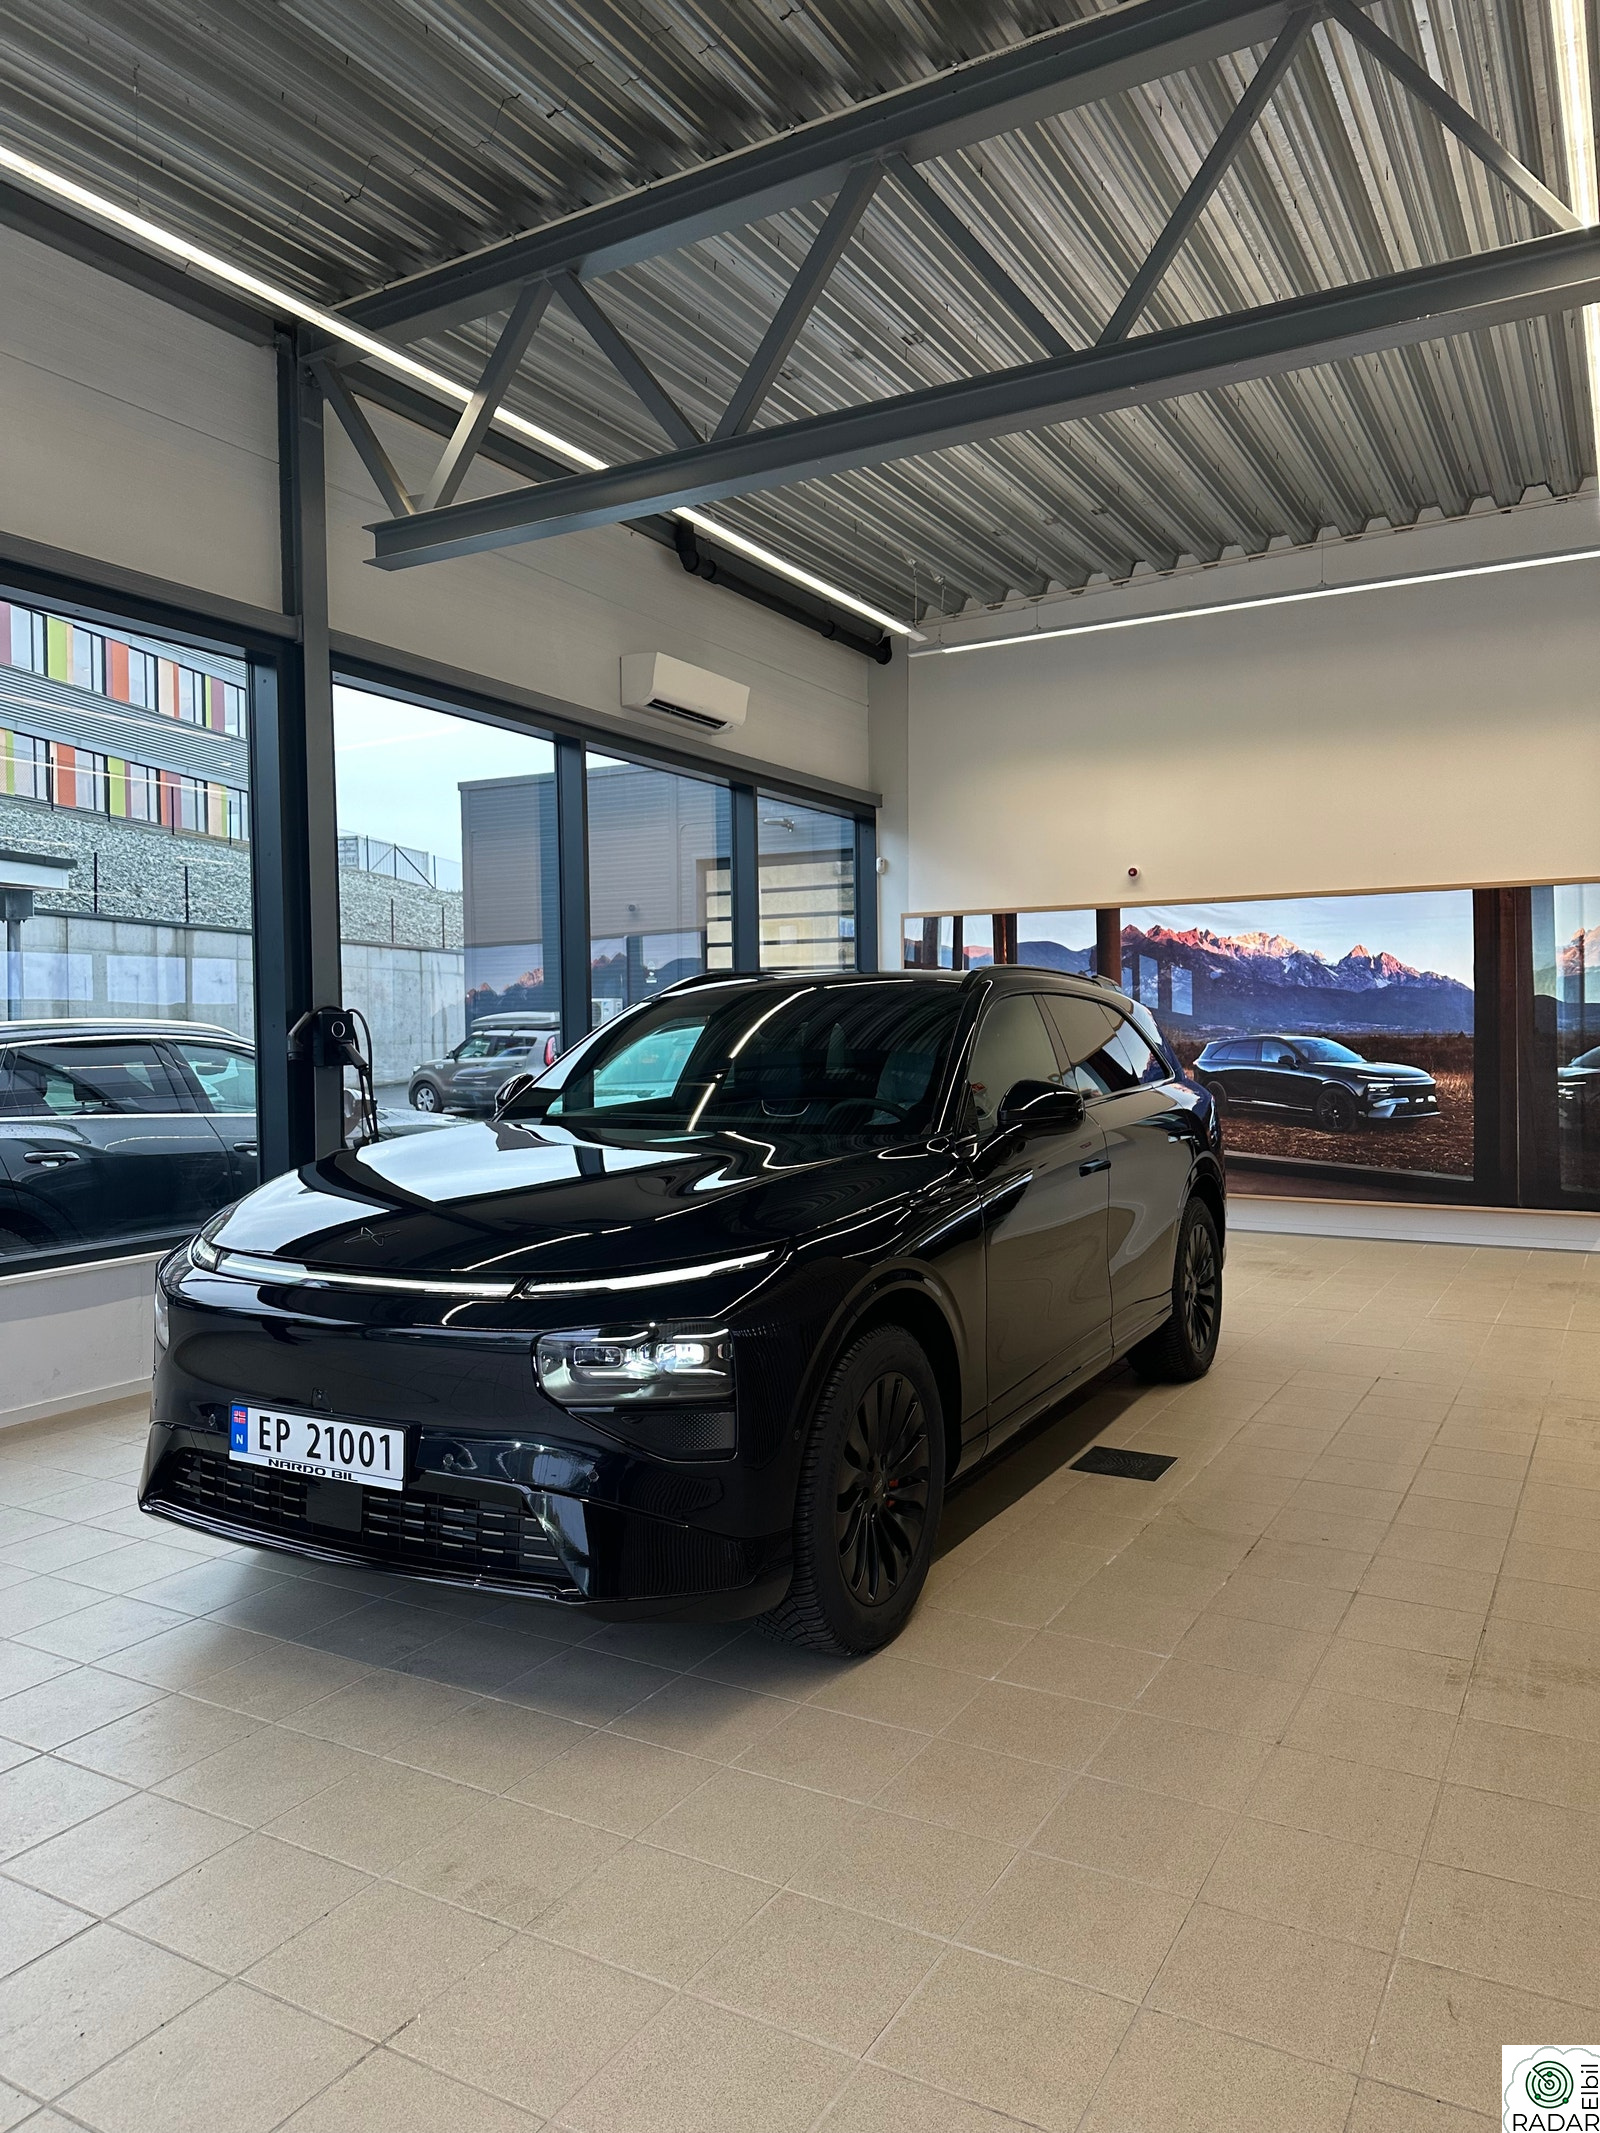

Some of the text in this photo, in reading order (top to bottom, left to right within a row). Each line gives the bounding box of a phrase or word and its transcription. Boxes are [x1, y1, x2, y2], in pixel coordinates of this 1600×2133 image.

[236, 1433, 244, 1445] N
[259, 1415, 391, 1471] EP 21001
[268, 1458, 359, 1482] NARDO BIL
